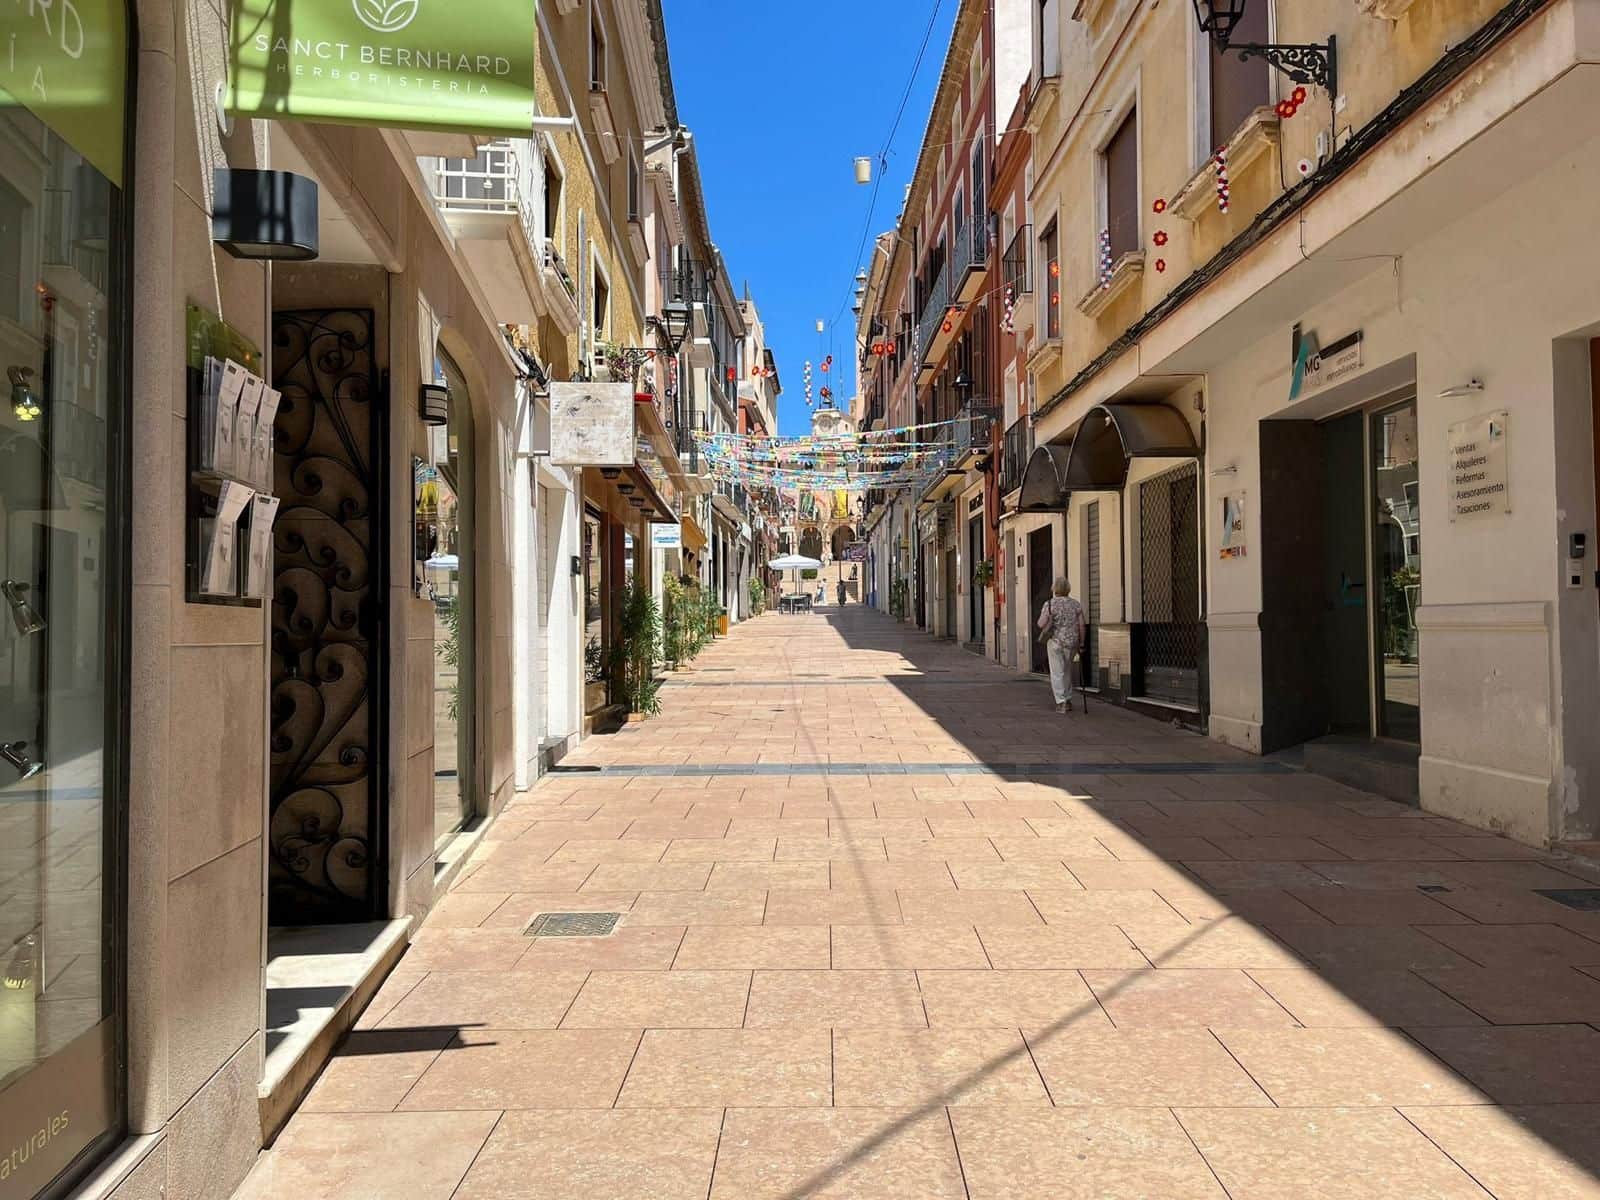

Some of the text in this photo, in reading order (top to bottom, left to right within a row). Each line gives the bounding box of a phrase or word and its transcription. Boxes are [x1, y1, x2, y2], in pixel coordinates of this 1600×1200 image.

[255, 34, 511, 75] SANCT BERNHARD
[1304, 355, 1320, 377] MG
[1455, 443, 1476, 455] Ventas
[1456, 456, 1487, 470] Alquileres
[1456, 472, 1486, 485] Reformas
[1456, 483, 1504, 500] Asesoramiento
[1456, 502, 1491, 514] Tasaciones
[0, 1109, 71, 1180] aturales
